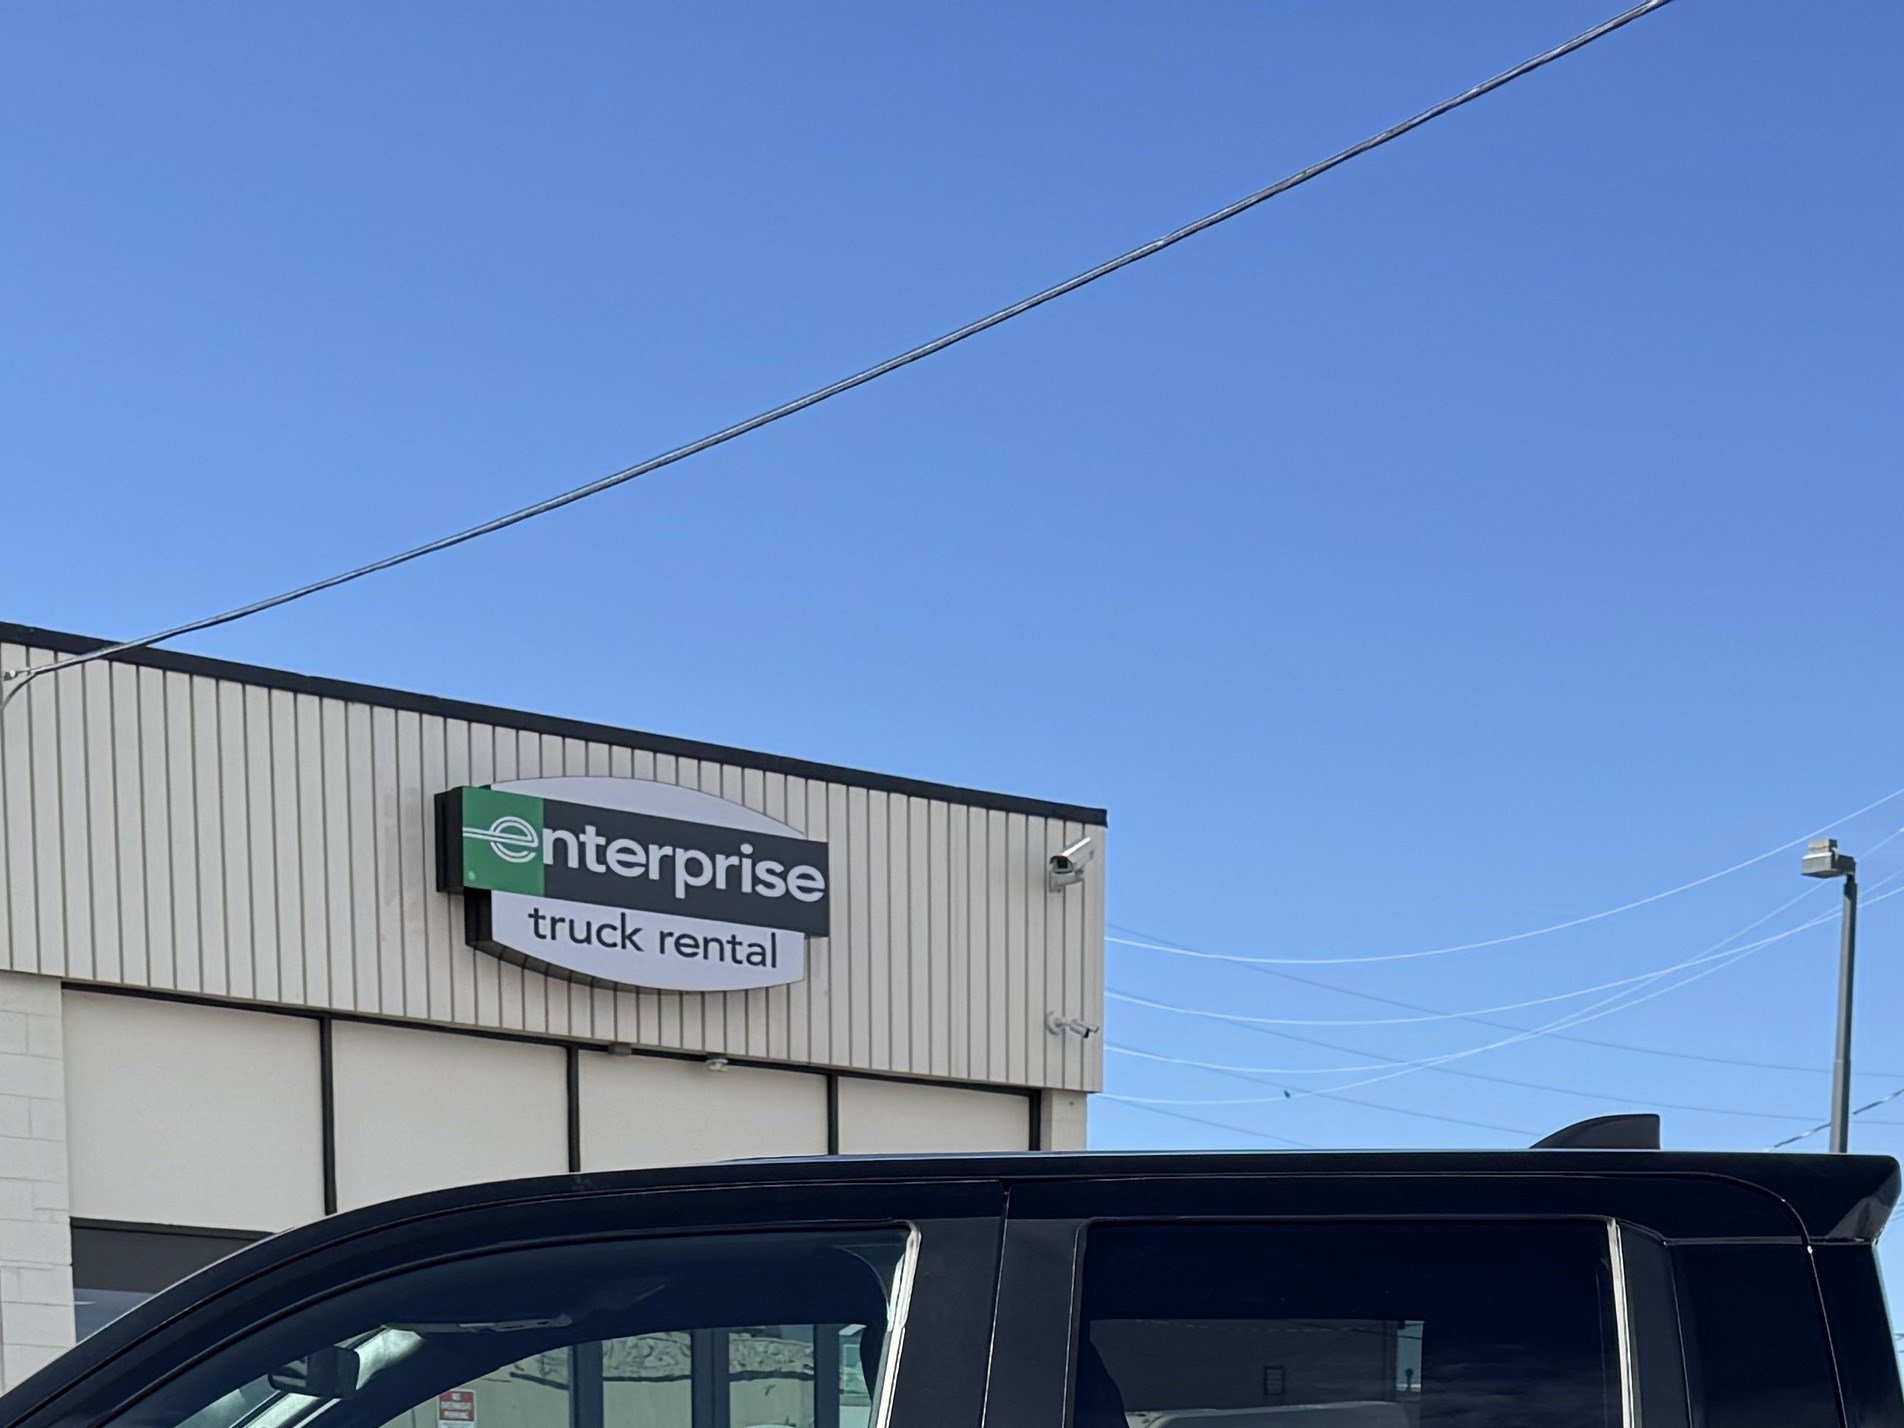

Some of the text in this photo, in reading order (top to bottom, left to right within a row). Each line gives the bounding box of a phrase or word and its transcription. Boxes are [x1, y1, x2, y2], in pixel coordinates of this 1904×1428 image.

[463, 815, 826, 903] enterprise
[527, 907, 778, 969] truck rental
